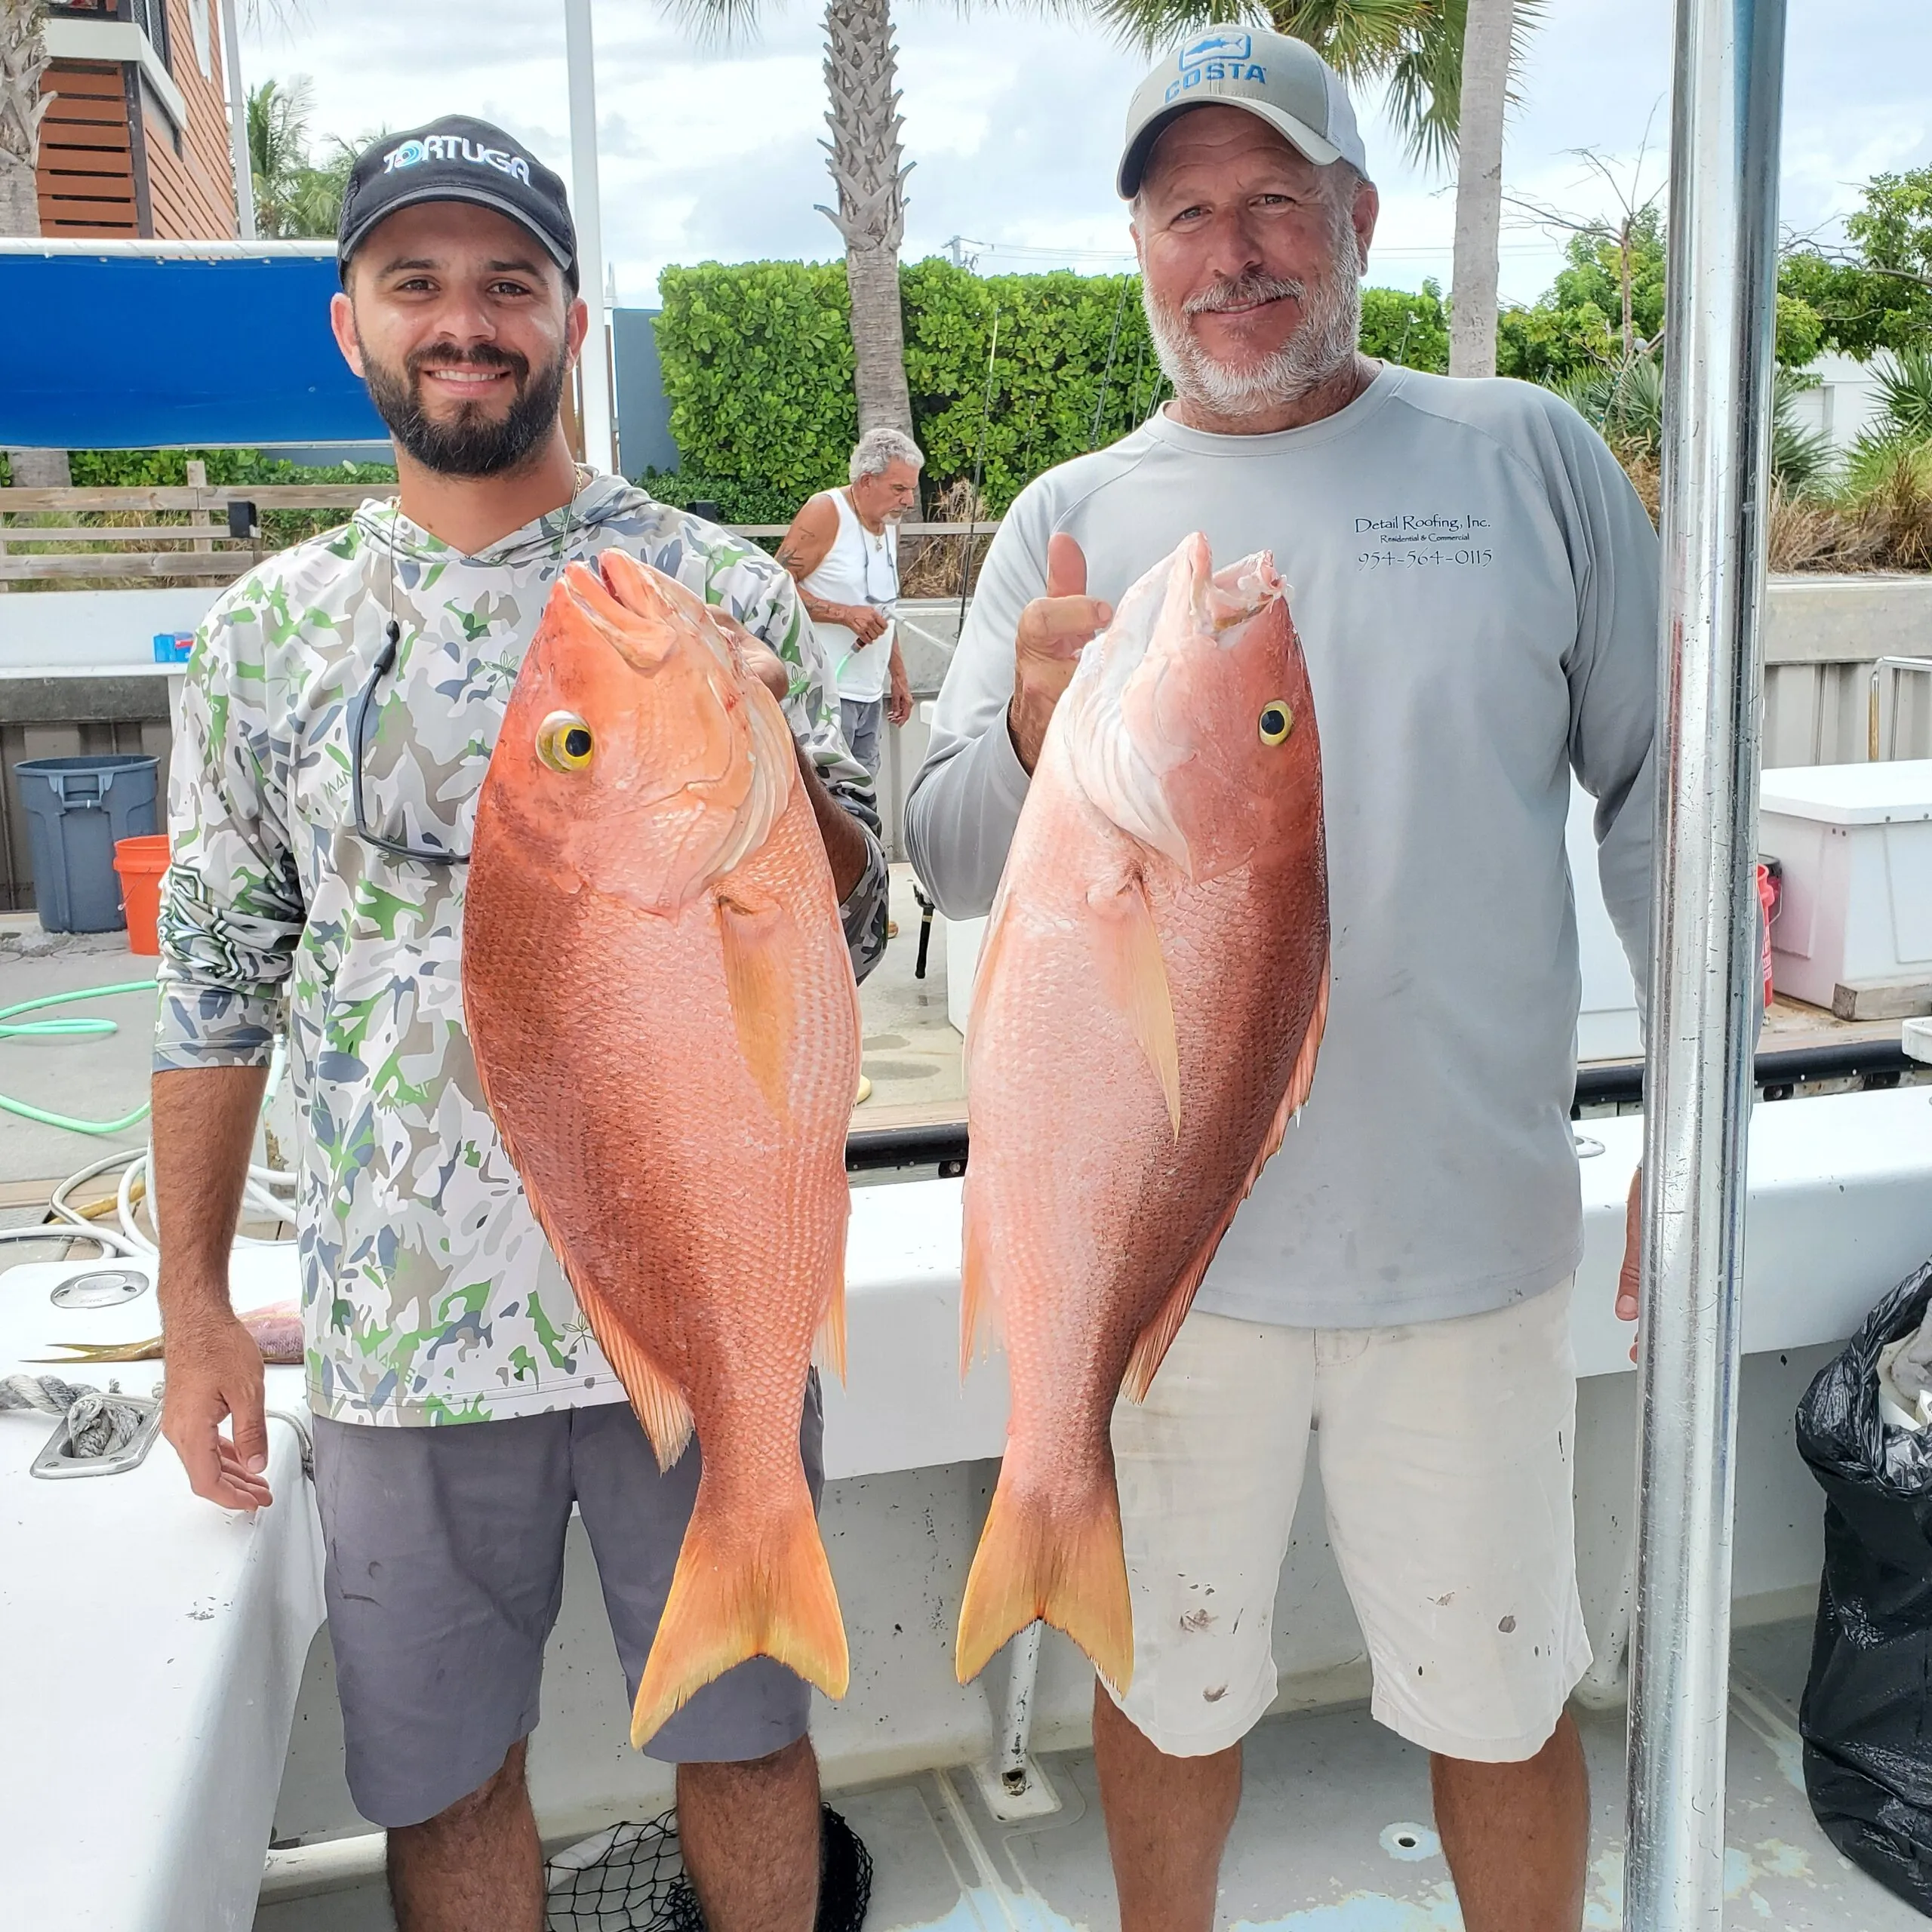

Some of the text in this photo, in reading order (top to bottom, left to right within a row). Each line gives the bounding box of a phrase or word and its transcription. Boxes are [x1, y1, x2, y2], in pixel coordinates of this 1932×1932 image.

[1164, 62, 1266, 104] COSTA
[383, 134, 531, 188] TORTUGA
[1355, 514, 1491, 533] Detail Roofing, Inc.
[1380, 534, 1420, 543] Residential
[1428, 533, 1470, 543] Commercial
[1358, 547, 1493, 571] 954-564-0115
